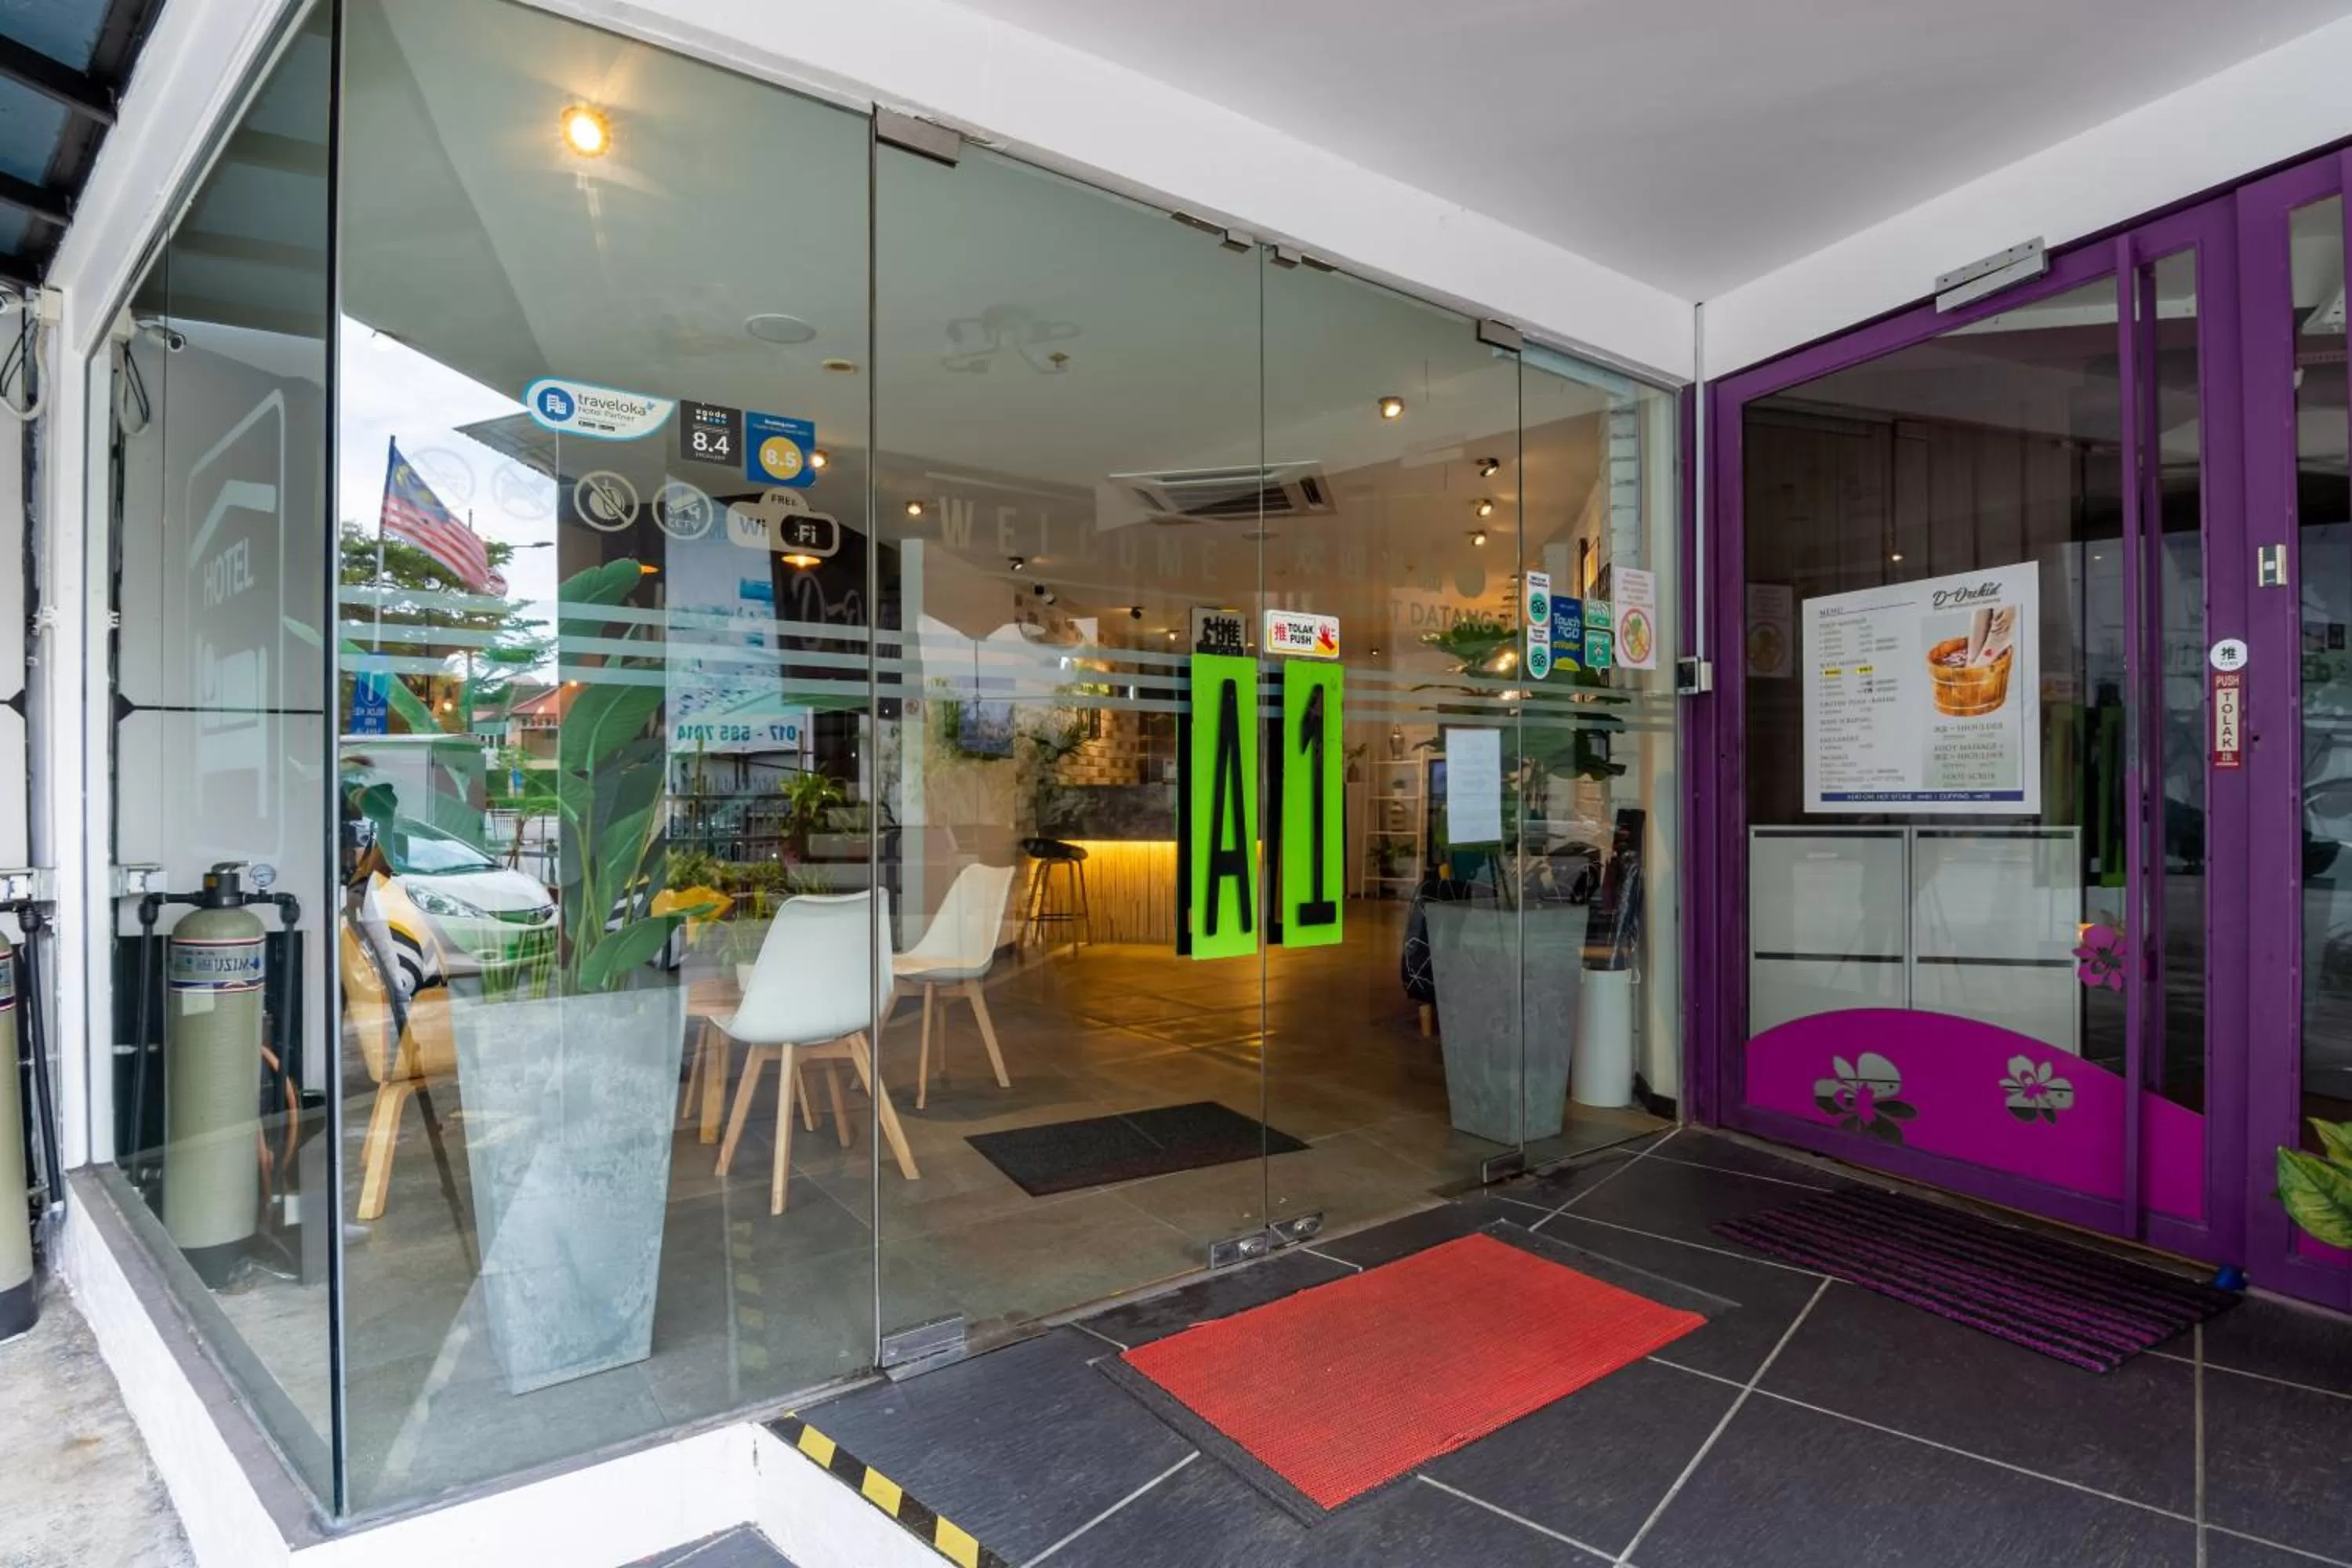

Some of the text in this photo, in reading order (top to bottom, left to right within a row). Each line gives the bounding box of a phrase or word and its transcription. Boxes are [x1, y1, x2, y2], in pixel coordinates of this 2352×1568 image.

[578, 392, 647, 416] traveloka
[695, 408, 728, 419] agoda
[692, 432, 731, 456] 8.4
[765, 448, 798, 469] 8.5
[771, 493, 797, 507] FREE
[202, 537, 256, 609] HOTEL
[1410, 601, 1494, 633] DATANG
[1553, 612, 1581, 627] Touch
[1274, 622, 1287, 642] 推
[1288, 623, 1314, 634] TOLAK
[1290, 633, 1312, 645] PUSH
[2220, 646, 2237, 661] 推
[2216, 675, 2240, 688] PUSH
[2221, 692, 2234, 747] TOLAK
